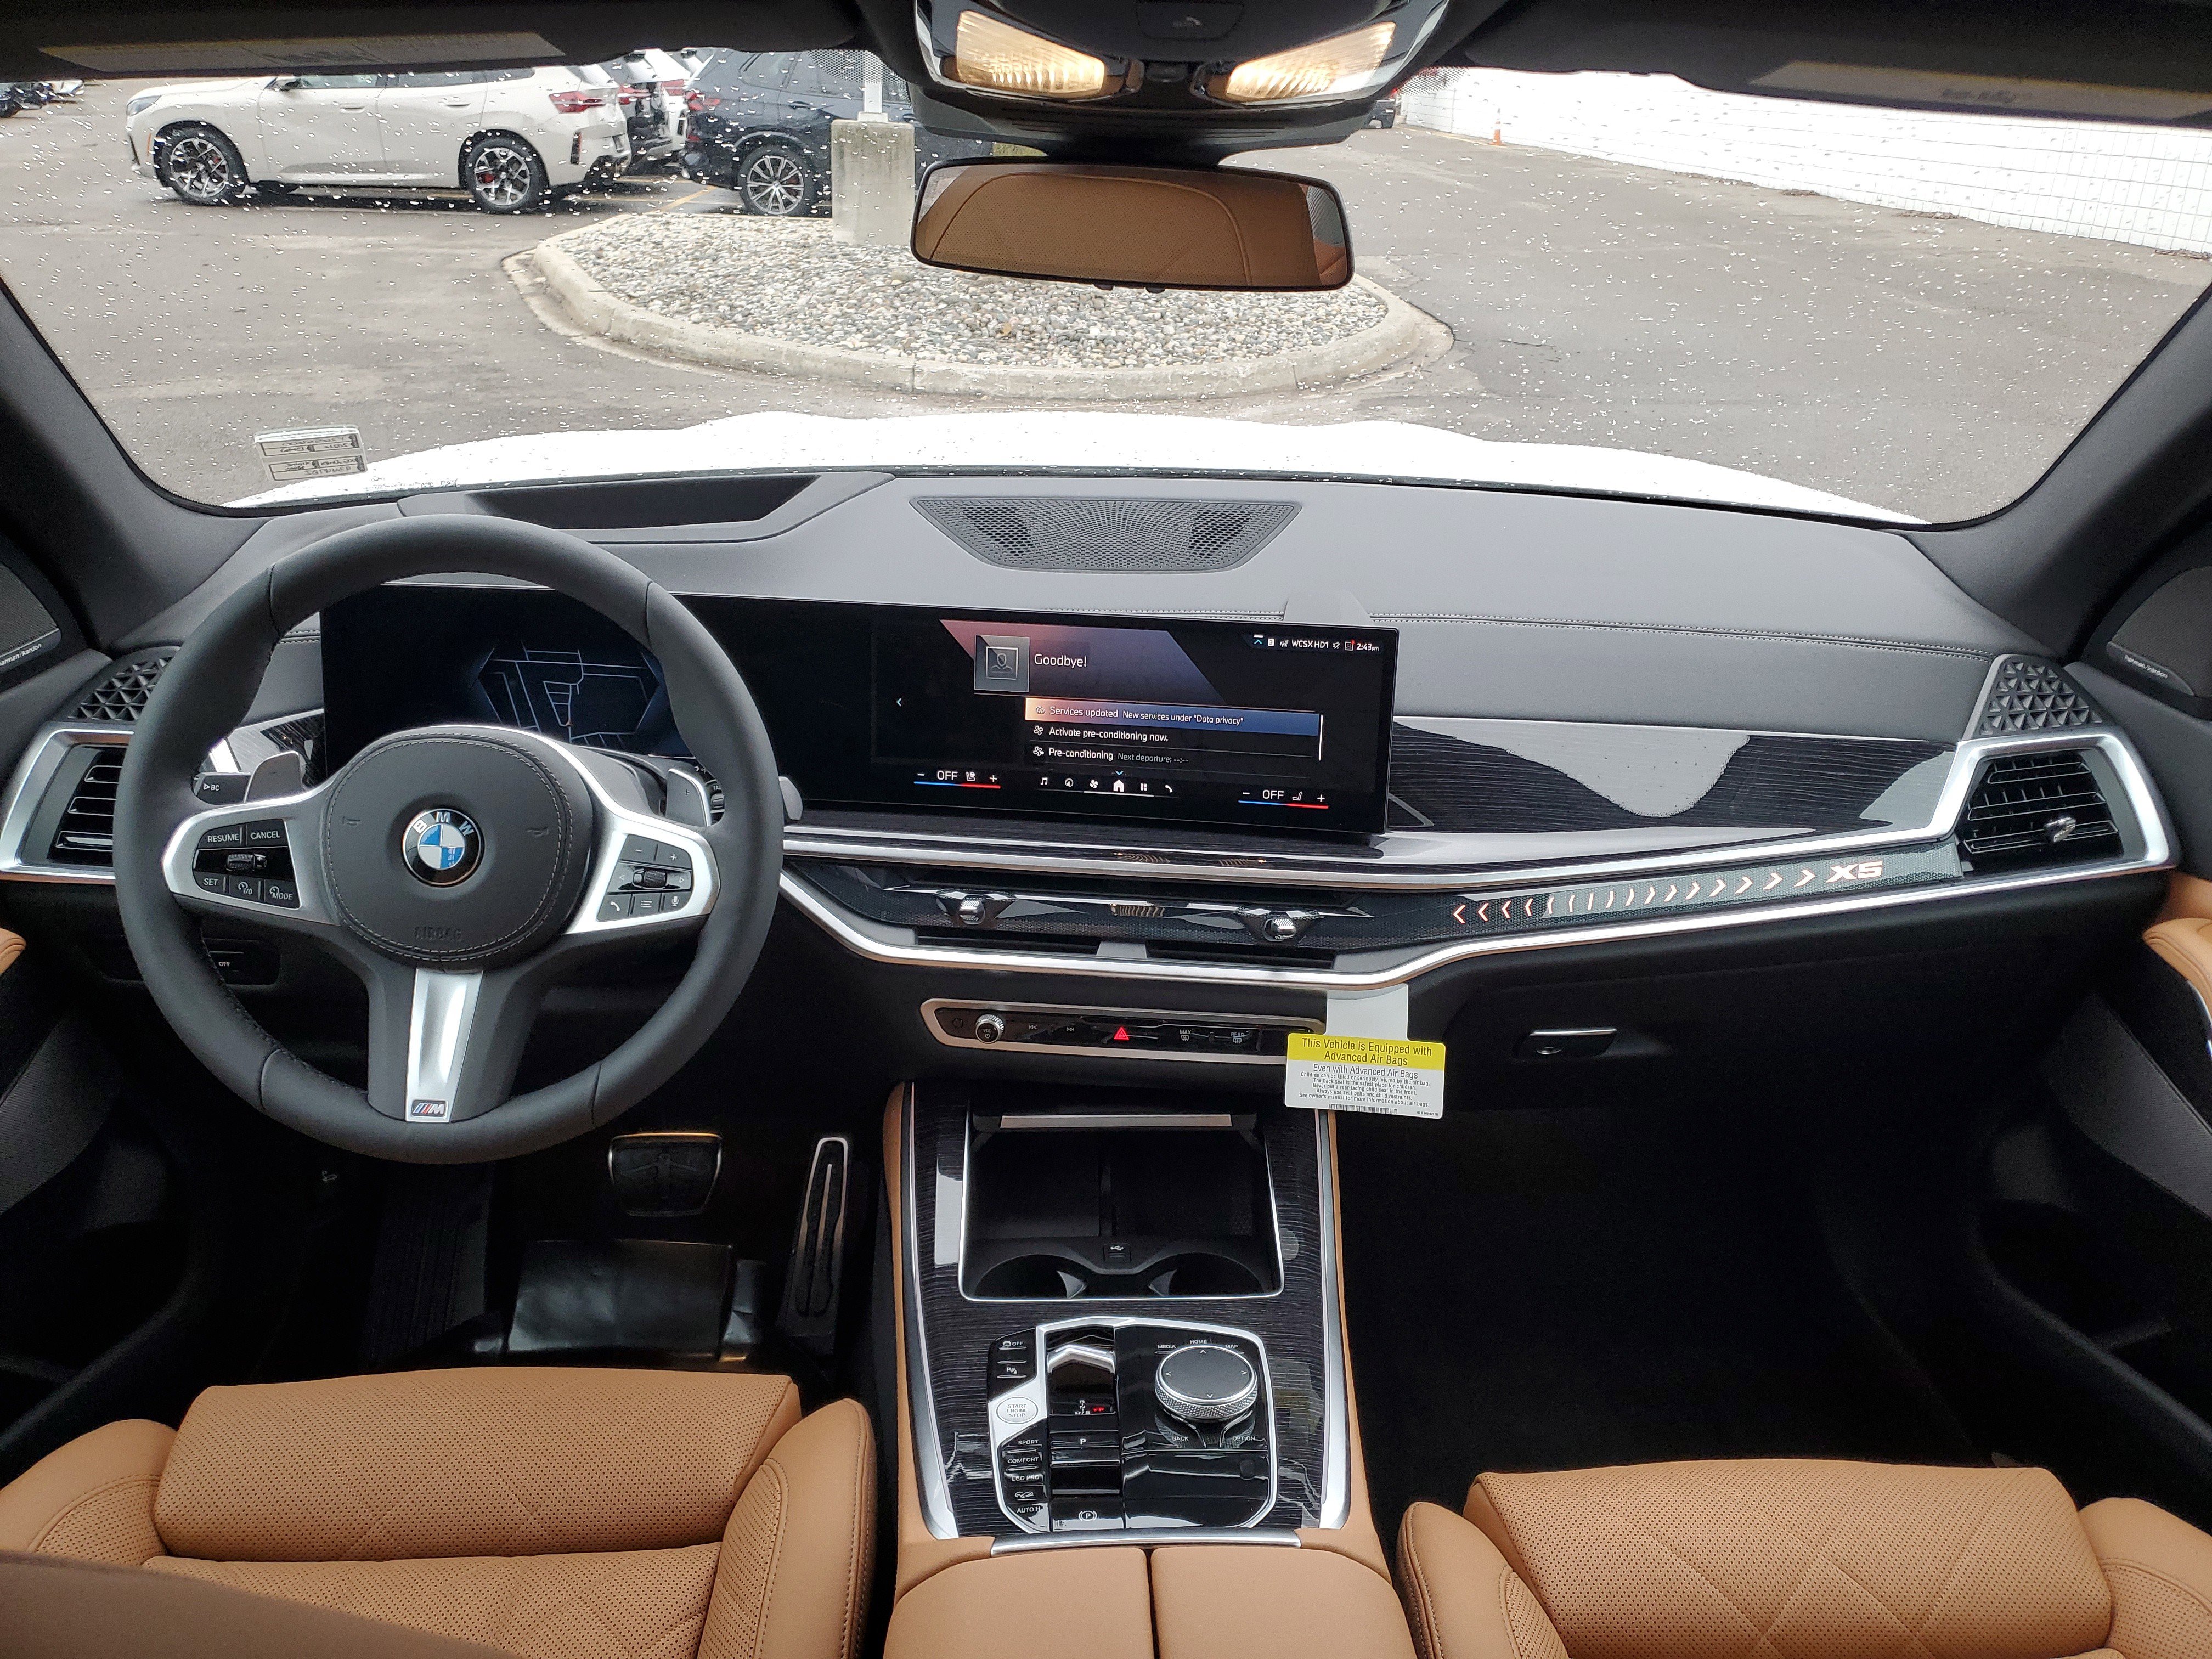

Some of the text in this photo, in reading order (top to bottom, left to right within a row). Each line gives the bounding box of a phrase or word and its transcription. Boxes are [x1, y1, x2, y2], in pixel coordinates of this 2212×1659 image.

[1291, 639, 1329, 648] WCSX HD1
[0, 644, 42, 667] arman/kardon
[1034, 654, 1087, 668] Goodbye!
[1049, 706, 1244, 726] Services updated New services under "Data privacy"
[1049, 727, 1169, 742] Activate pre-conditioning now.
[1048, 747, 1114, 761] Pre-conditioning
[1118, 752, 1134, 761] Next
[937, 770, 958, 780] OFF
[1262, 789, 1284, 800] OFF
[413, 811, 475, 836] BMW
[207, 831, 281, 843] RESUME CANCEL
[1825, 861, 1883, 883] X5
[204, 878, 219, 886] SET
[272, 892, 293, 900] MODE
[1302, 1037, 1432, 1056] This Vehicle is Equipped with
[1324, 1051, 1408, 1066] Advanced Air Bags
[1313, 1064, 1418, 1080] Even with Advanced Air Bags
